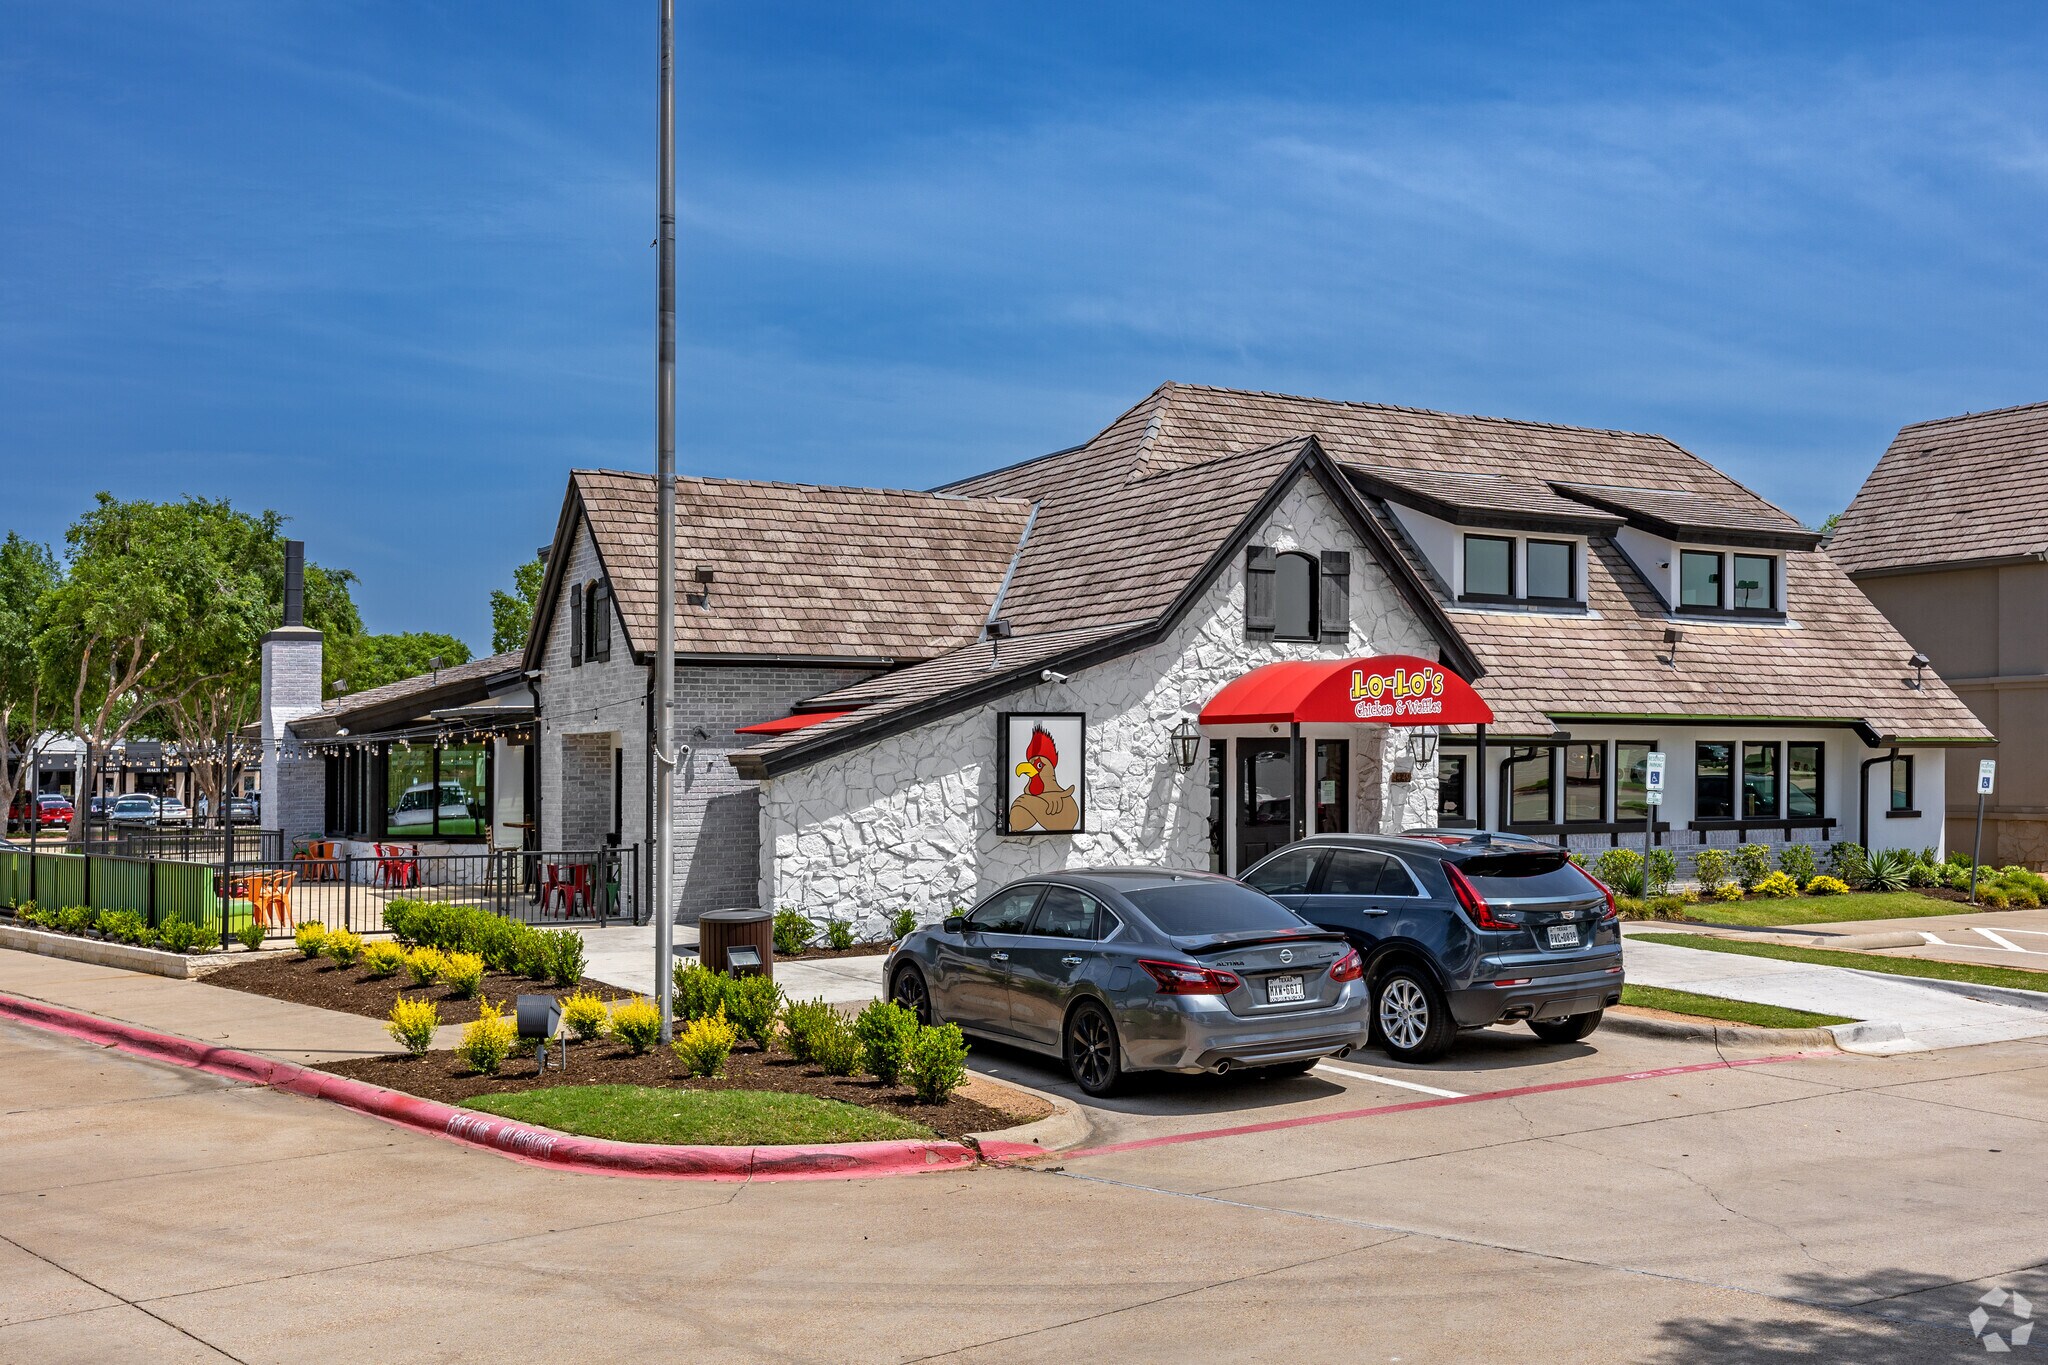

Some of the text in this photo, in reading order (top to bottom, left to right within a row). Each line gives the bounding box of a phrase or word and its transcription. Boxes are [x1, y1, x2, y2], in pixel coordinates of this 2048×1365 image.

[1355, 698, 1442, 717] Chicken & Waffles
[497, 1125, 517, 1145] NO
[511, 1129, 558, 1159] PARKING
